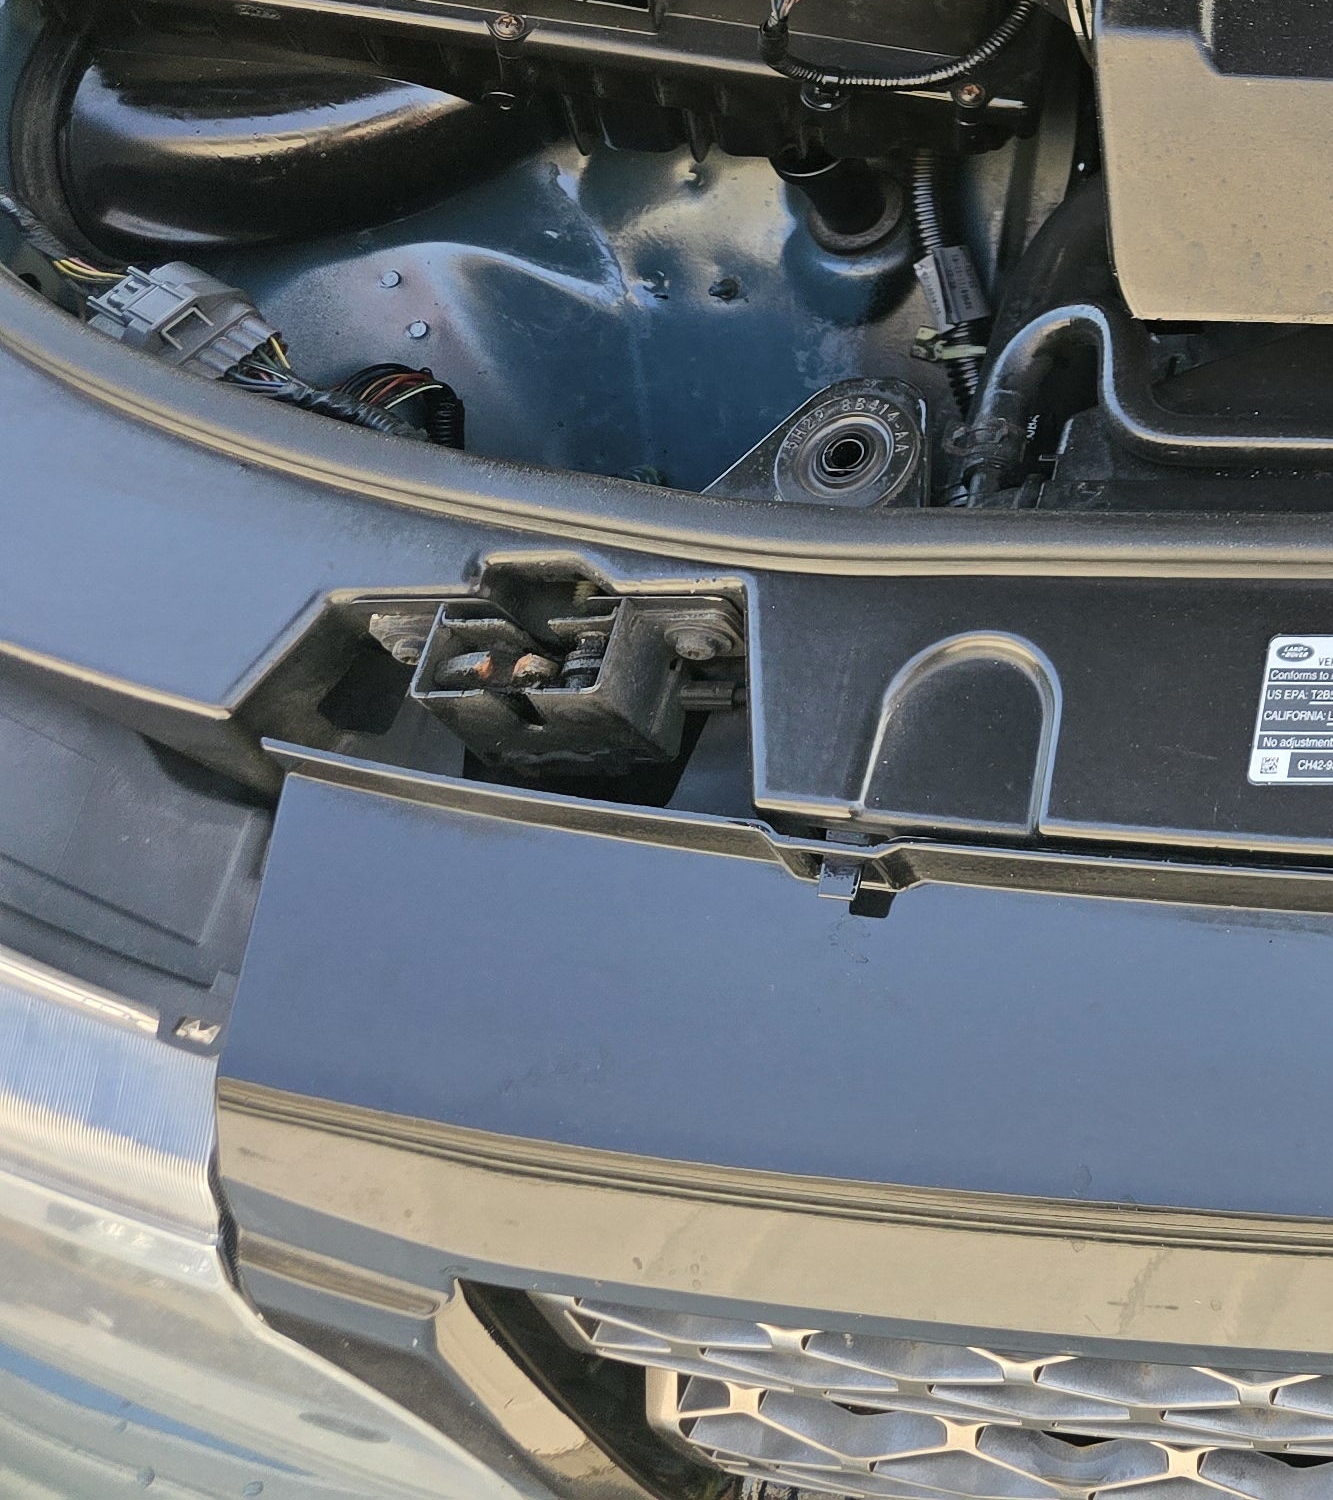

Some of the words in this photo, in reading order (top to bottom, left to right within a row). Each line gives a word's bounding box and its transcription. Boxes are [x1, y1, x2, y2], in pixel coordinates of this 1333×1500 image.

[1270, 670, 1317, 680] Conforms
[1319, 670, 1329, 680] to
[1267, 690, 1282, 700] US
[1284, 690, 1308, 700] EPA:
[1264, 710, 1327, 721] CALIFORNIA:
[1263, 737, 1277, 747] No
